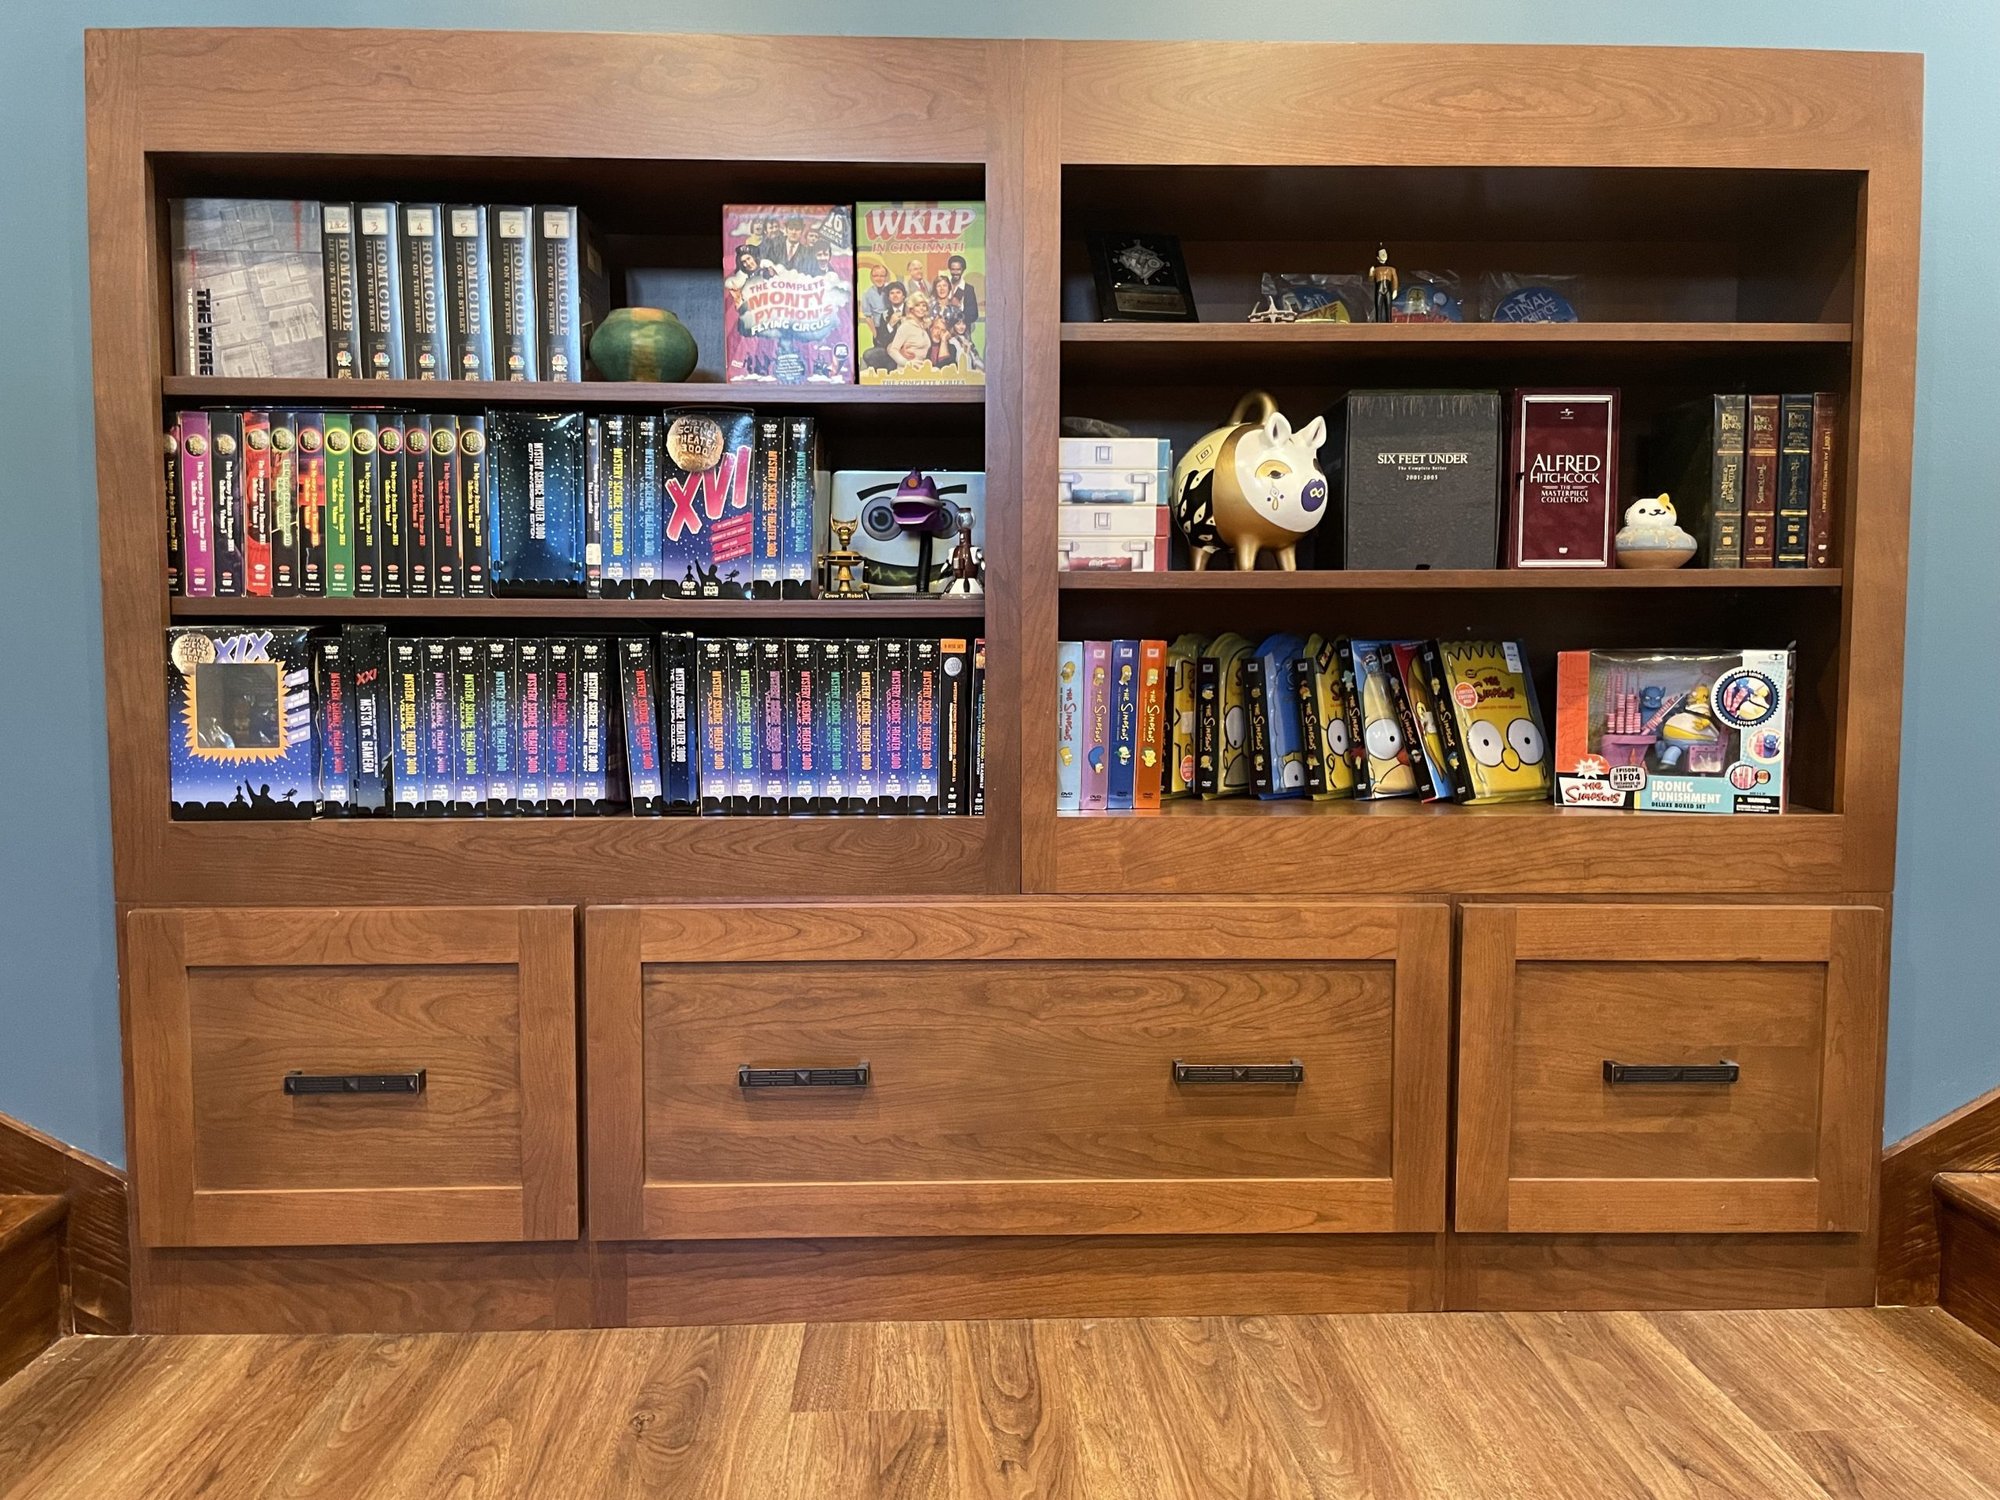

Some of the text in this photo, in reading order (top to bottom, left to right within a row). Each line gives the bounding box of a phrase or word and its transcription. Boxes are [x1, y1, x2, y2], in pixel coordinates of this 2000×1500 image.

[371, 221, 378, 232] 3
[416, 222, 424, 232] 4
[460, 222, 468, 234] 5
[508, 224, 516, 234] 6
[552, 223, 560, 234] 7
[866, 208, 976, 239] WKRP
[872, 240, 966, 254] IN CINCINNATI
[330, 261, 336, 274] ON
[367, 263, 373, 275] ON
[339, 239, 353, 331] HOMICIDE
[376, 240, 391, 332] HOMICIDE
[422, 241, 436, 334] HOMICIDE
[466, 242, 481, 335] HOMICIDE
[514, 242, 526, 336] HOMICIDE
[558, 243, 570, 336] HOMICIDE
[750, 279, 825, 294] THE COMPLETE
[748, 288, 826, 311] MONTY
[1503, 293, 1552, 321] FINAL
[368, 298, 376, 332] STREET
[751, 316, 831, 336] FLYING CIRCUS
[754, 304, 834, 324] PYTHON'S
[197, 288, 214, 376] THE WIRE
[676, 434, 717, 451] THEATER
[678, 426, 717, 440] SCIENCE
[681, 444, 708, 456] 3000
[1377, 454, 1468, 464] SIX FEET UNDER
[1533, 454, 1600, 472] ALFRED
[533, 442, 546, 540] MYSTERY SCIENCE THEATER 3000
[1530, 472, 1600, 484] HITCHCOCK
[612, 448, 624, 556] MYSTERY SCIENCE THEATER 3000
[665, 445, 751, 542] XVI
[213, 631, 274, 664] XIX
[355, 668, 378, 686] XXI
[360, 699, 372, 727] MST3K
[404, 674, 417, 774] MYSTERY SCIENCE THEATER 3000
[589, 672, 598, 772] MYSTERY SCIENCE THEATER 3000
[675, 668, 686, 762] MYSTERY SCIENCE THEATER 3000
[801, 671, 812, 770] MYSTERY SCIENCE THEATER 3000
[861, 672, 872, 770] MYSTERY SCIENCE THEATER 3000
[1064, 703, 1076, 741] SIMPSONS
[1094, 705, 1106, 743] SIMPSONS
[1120, 703, 1134, 741] SIMPSONS
[1146, 705, 1160, 743] SIMPSONS
[362, 741, 374, 773] GAMERA
[1565, 786, 1621, 804] SIMPSONS
[1582, 782, 1603, 790] THE
[1651, 780, 1694, 792] IRONIC
[1651, 792, 1722, 804] PUNISHMENT
